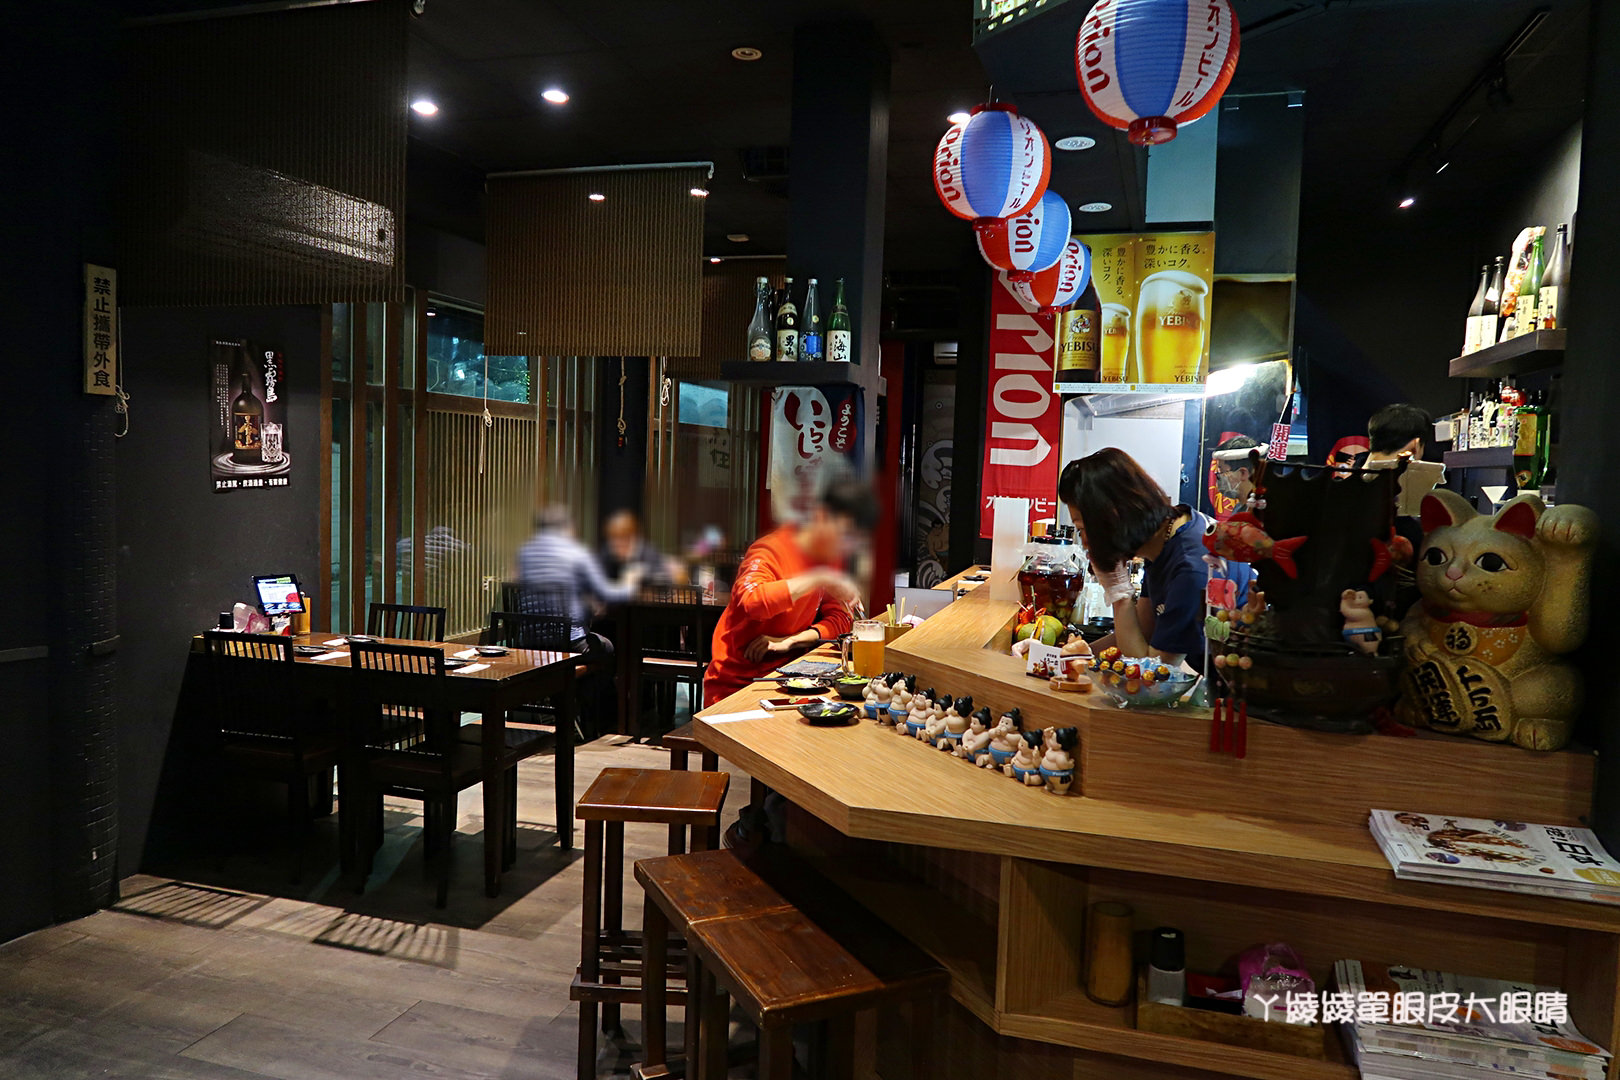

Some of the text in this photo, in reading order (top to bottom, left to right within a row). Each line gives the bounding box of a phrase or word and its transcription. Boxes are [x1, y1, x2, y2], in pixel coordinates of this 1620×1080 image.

[1174, 0, 1220, 107] オンビール
[1145, 243, 1206, 257] 豊かに香る。
[1143, 258, 1191, 270] 深いコク。
[93, 277, 111, 388] 禁止攜帶外食
[785, 334, 796, 357] 男山
[833, 333, 847, 361] 八海山
[1446, 625, 1472, 651] 福
